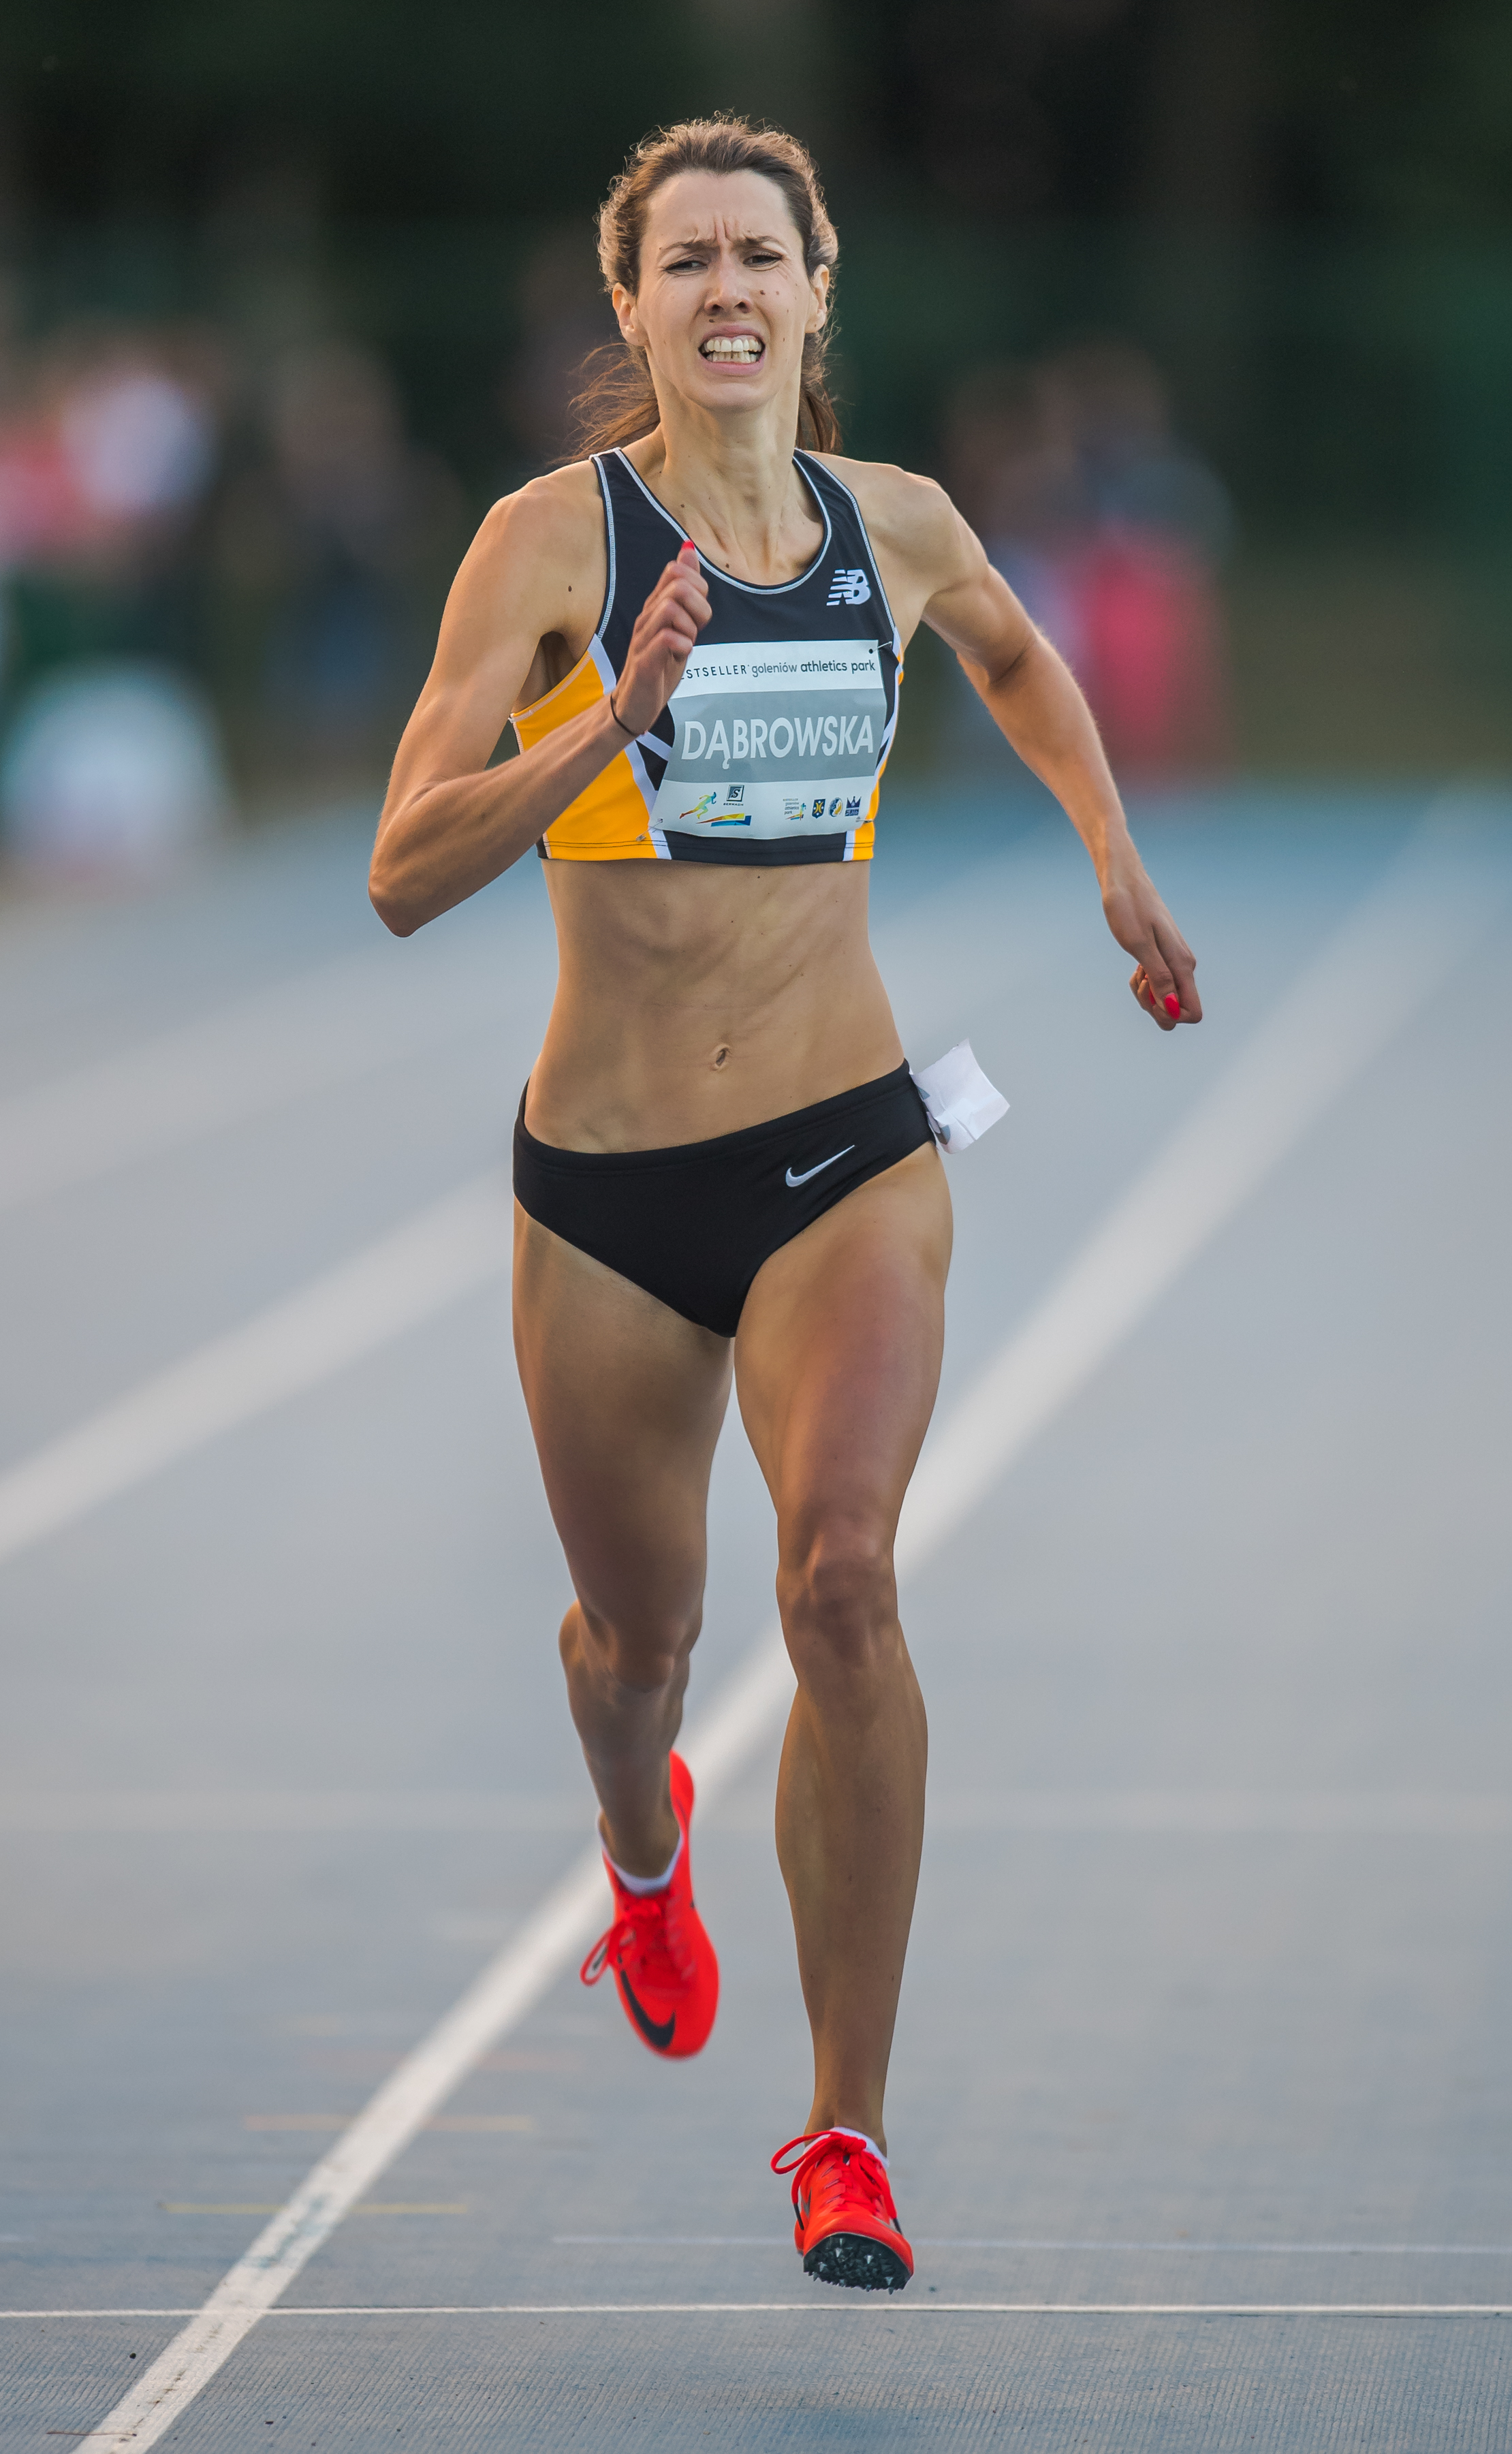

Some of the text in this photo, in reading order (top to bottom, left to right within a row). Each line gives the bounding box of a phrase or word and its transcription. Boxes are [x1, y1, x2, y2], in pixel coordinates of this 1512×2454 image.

[681, 660, 876, 680] STSELLER goleniów athletics park
[681, 715, 873, 770] DĄBROWSKA
